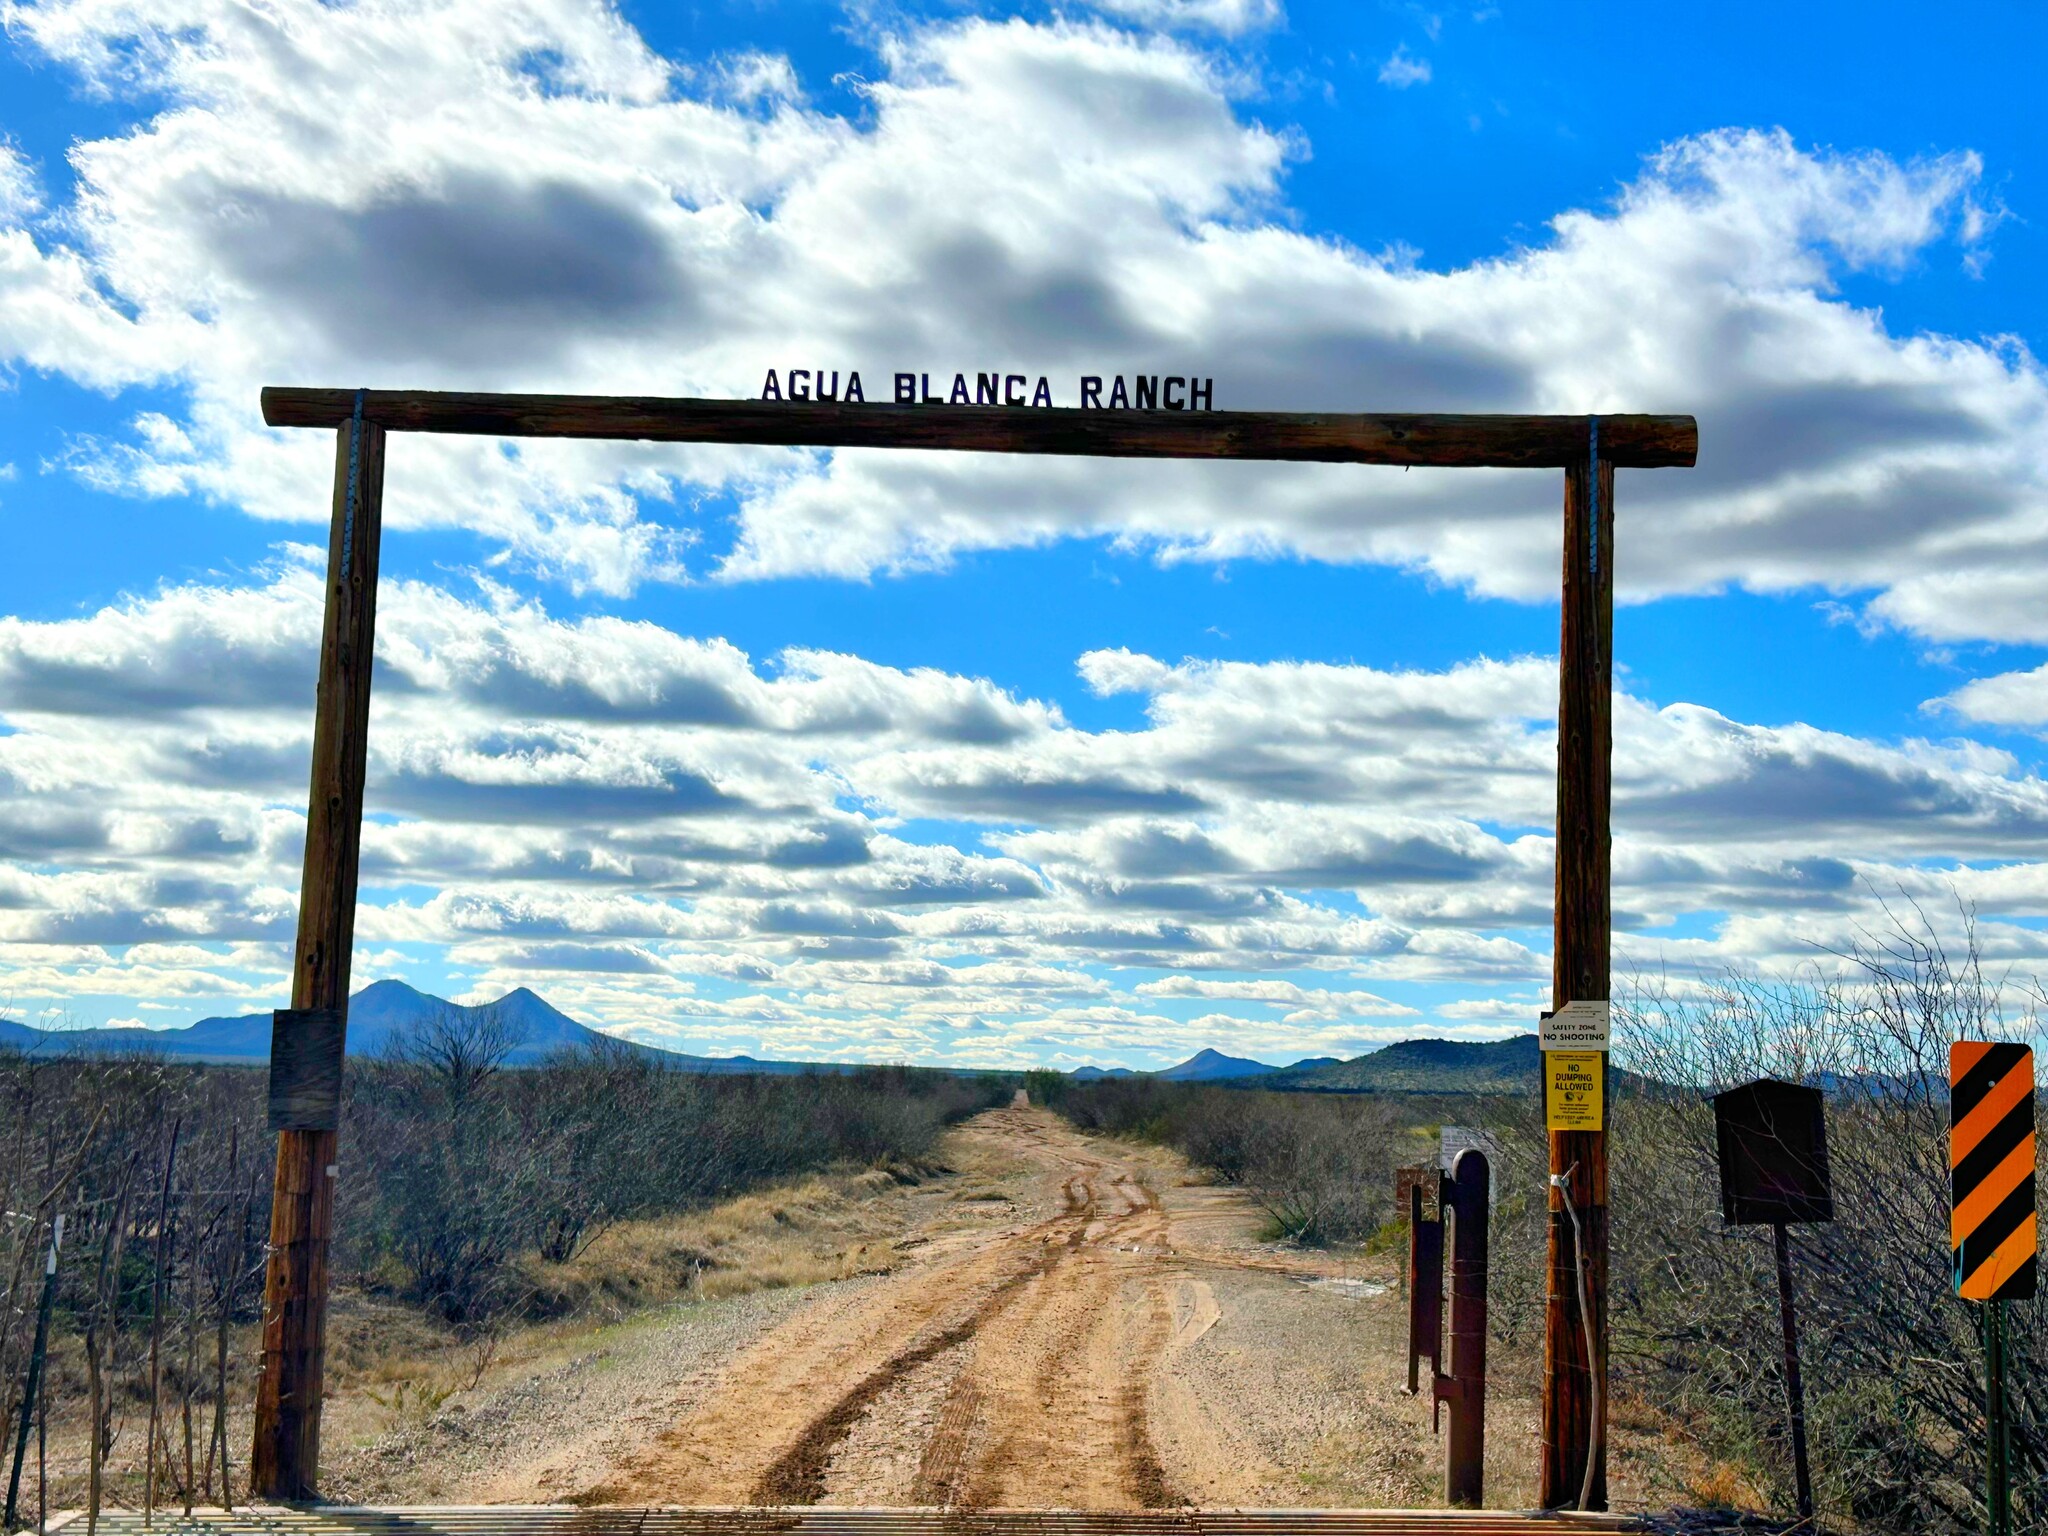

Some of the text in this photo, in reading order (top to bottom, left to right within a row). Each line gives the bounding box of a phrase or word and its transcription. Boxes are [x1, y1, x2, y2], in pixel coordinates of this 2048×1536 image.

[761, 368, 1213, 411] AGUA BLANCA RANCH
[1568, 1064, 1580, 1072] NO
[1555, 1073, 1592, 1081] DUMPING
[1555, 1082, 1594, 1090] ALLOWED
